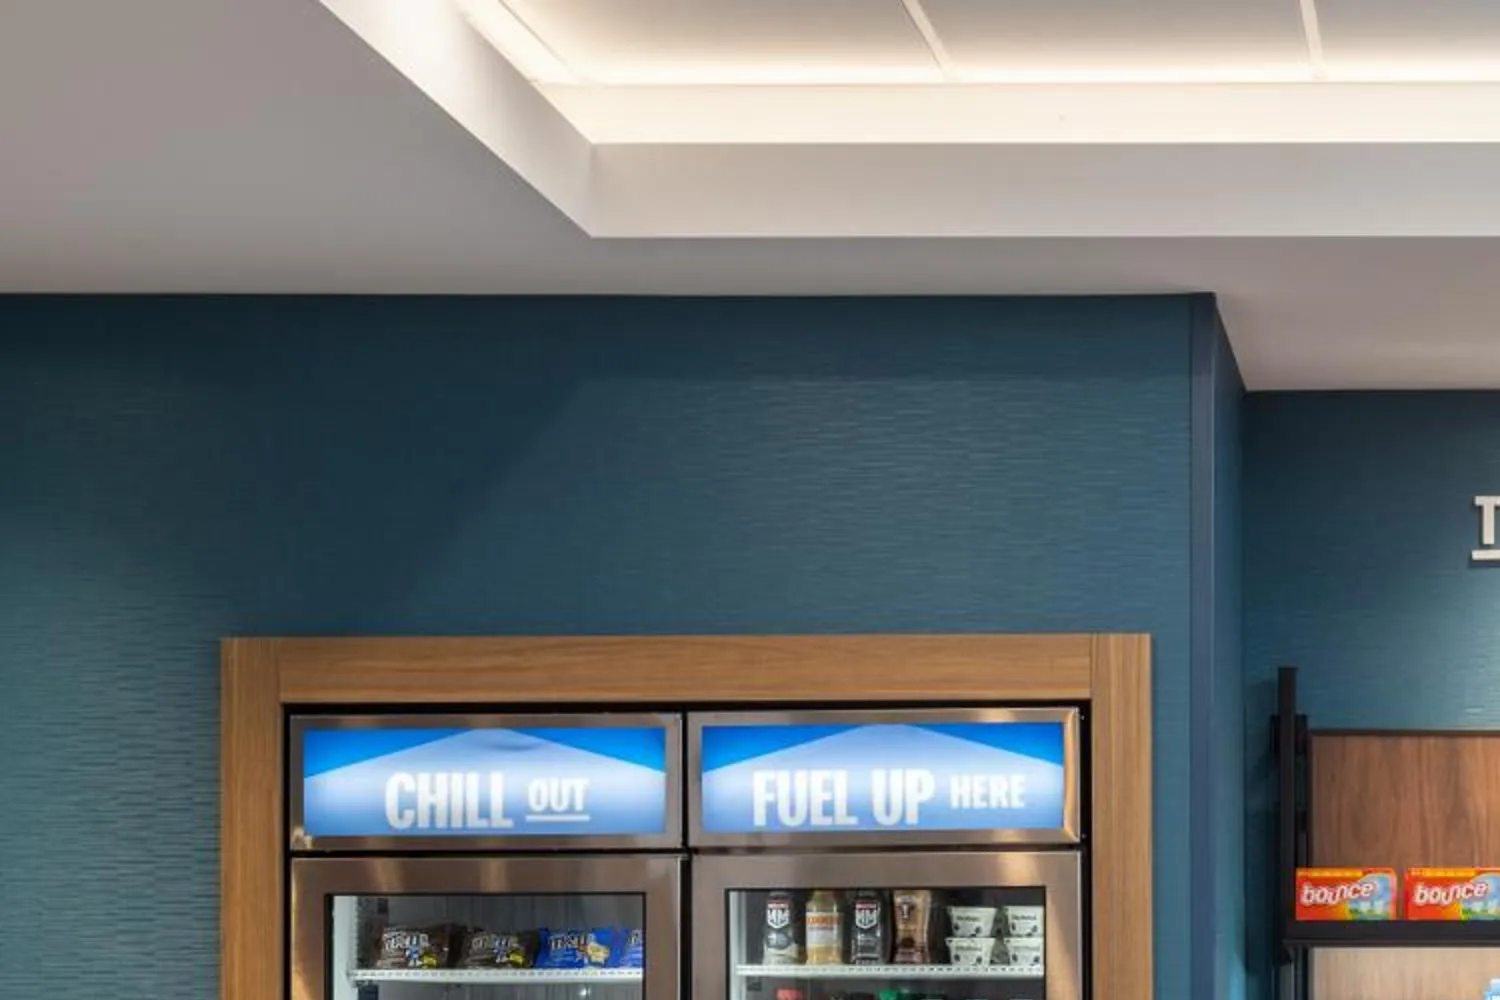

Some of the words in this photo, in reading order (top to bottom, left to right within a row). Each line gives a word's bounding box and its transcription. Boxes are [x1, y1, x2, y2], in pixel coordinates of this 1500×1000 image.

[384, 772, 513, 829] CHILL
[528, 777, 590, 813] OUT
[752, 770, 857, 828] FUEL
[872, 768, 935, 826] UP
[949, 775, 1026, 811] HERE
[1301, 881, 1378, 905] bounce
[1413, 881, 1489, 906] bounce
